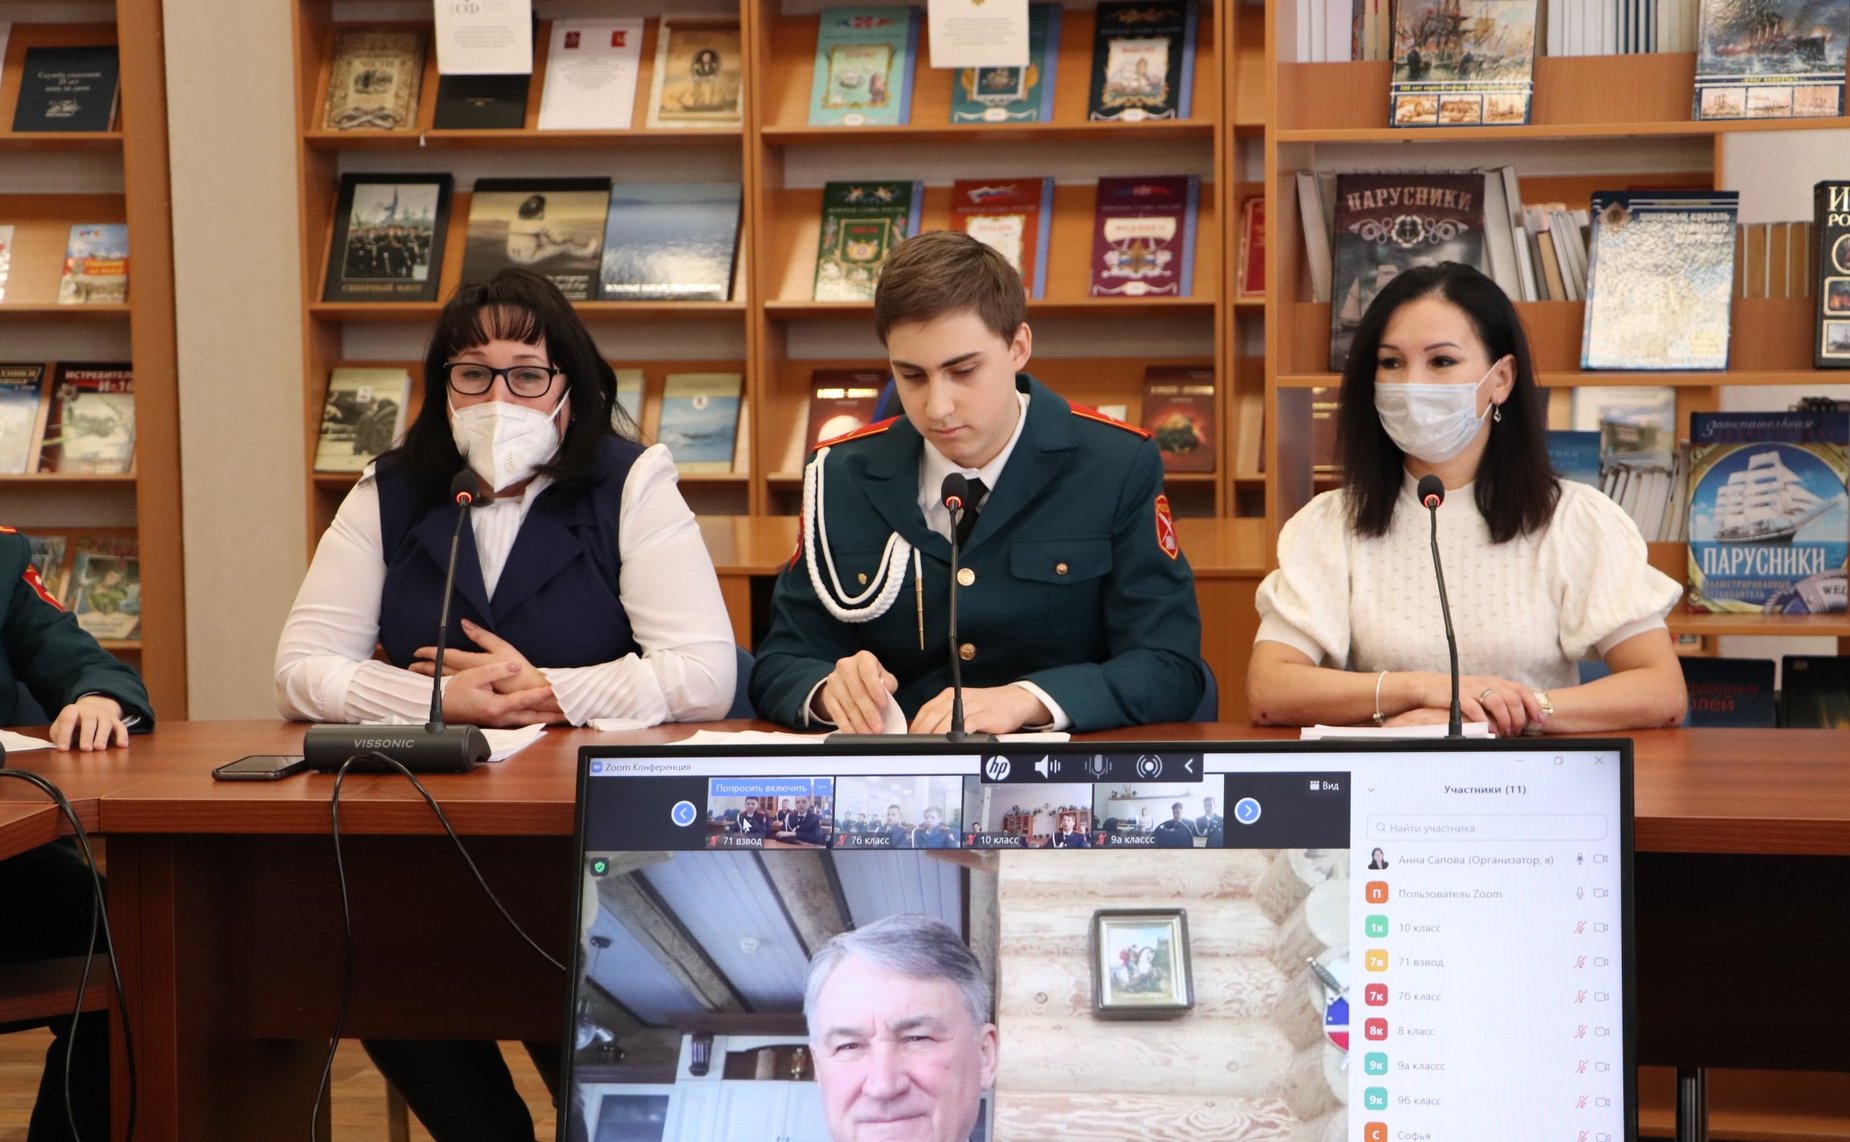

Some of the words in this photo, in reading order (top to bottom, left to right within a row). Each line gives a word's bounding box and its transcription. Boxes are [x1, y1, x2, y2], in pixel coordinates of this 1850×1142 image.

[1346, 186, 1473, 212] ПАРУСНИКИ
[1703, 547, 1826, 576] ПАРУСНИКИ
[354, 739, 415, 749] VISSONIC
[605, 763, 630, 772] Zoom
[632, 762, 691, 773] Конференция
[716, 784, 763, 795] Попросить
[766, 784, 806, 793] включить
[1322, 781, 1340, 792] Вид
[1444, 784, 1502, 794] Участники
[1505, 784, 1527, 796] (11)
[1390, 822, 1422, 832] Найти
[1424, 825, 1476, 834] участника
[723, 836, 734, 845] 71
[736, 838, 762, 847] взвод
[864, 836, 890, 844] класс
[980, 836, 991, 844] 10
[993, 836, 1019, 844] класс
[1111, 835, 1122, 844] 9а
[1124, 836, 1155, 844] классс
[1398, 856, 1425, 864] Анна
[1428, 856, 1465, 864] Сапова
[1468, 855, 1542, 866] (Организатор,
[1544, 855, 1554, 866] я)
[1398, 889, 1470, 899] Пользователь
[1473, 888, 1502, 898] Zoom
[1371, 922, 1384, 933] 1к
[1399, 923, 1410, 932] 10
[1413, 924, 1441, 932] класс
[1370, 957, 1384, 967] 7в
[1398, 958, 1410, 967] 71
[1413, 958, 1444, 968] взвод
[1370, 991, 1384, 1001] 7к
[1413, 993, 1442, 1001] класс
[1370, 1026, 1384, 1036] 8к
[1398, 1026, 1404, 1036] 8
[1406, 1028, 1435, 1036] класс
[1370, 1060, 1384, 1070] 9к
[1398, 1061, 1410, 1070] 9а
[1412, 1062, 1446, 1070] классс
[1370, 1096, 1384, 1106] 9к
[1413, 1097, 1442, 1106] класс
[1398, 1130, 1431, 1142] Софья
